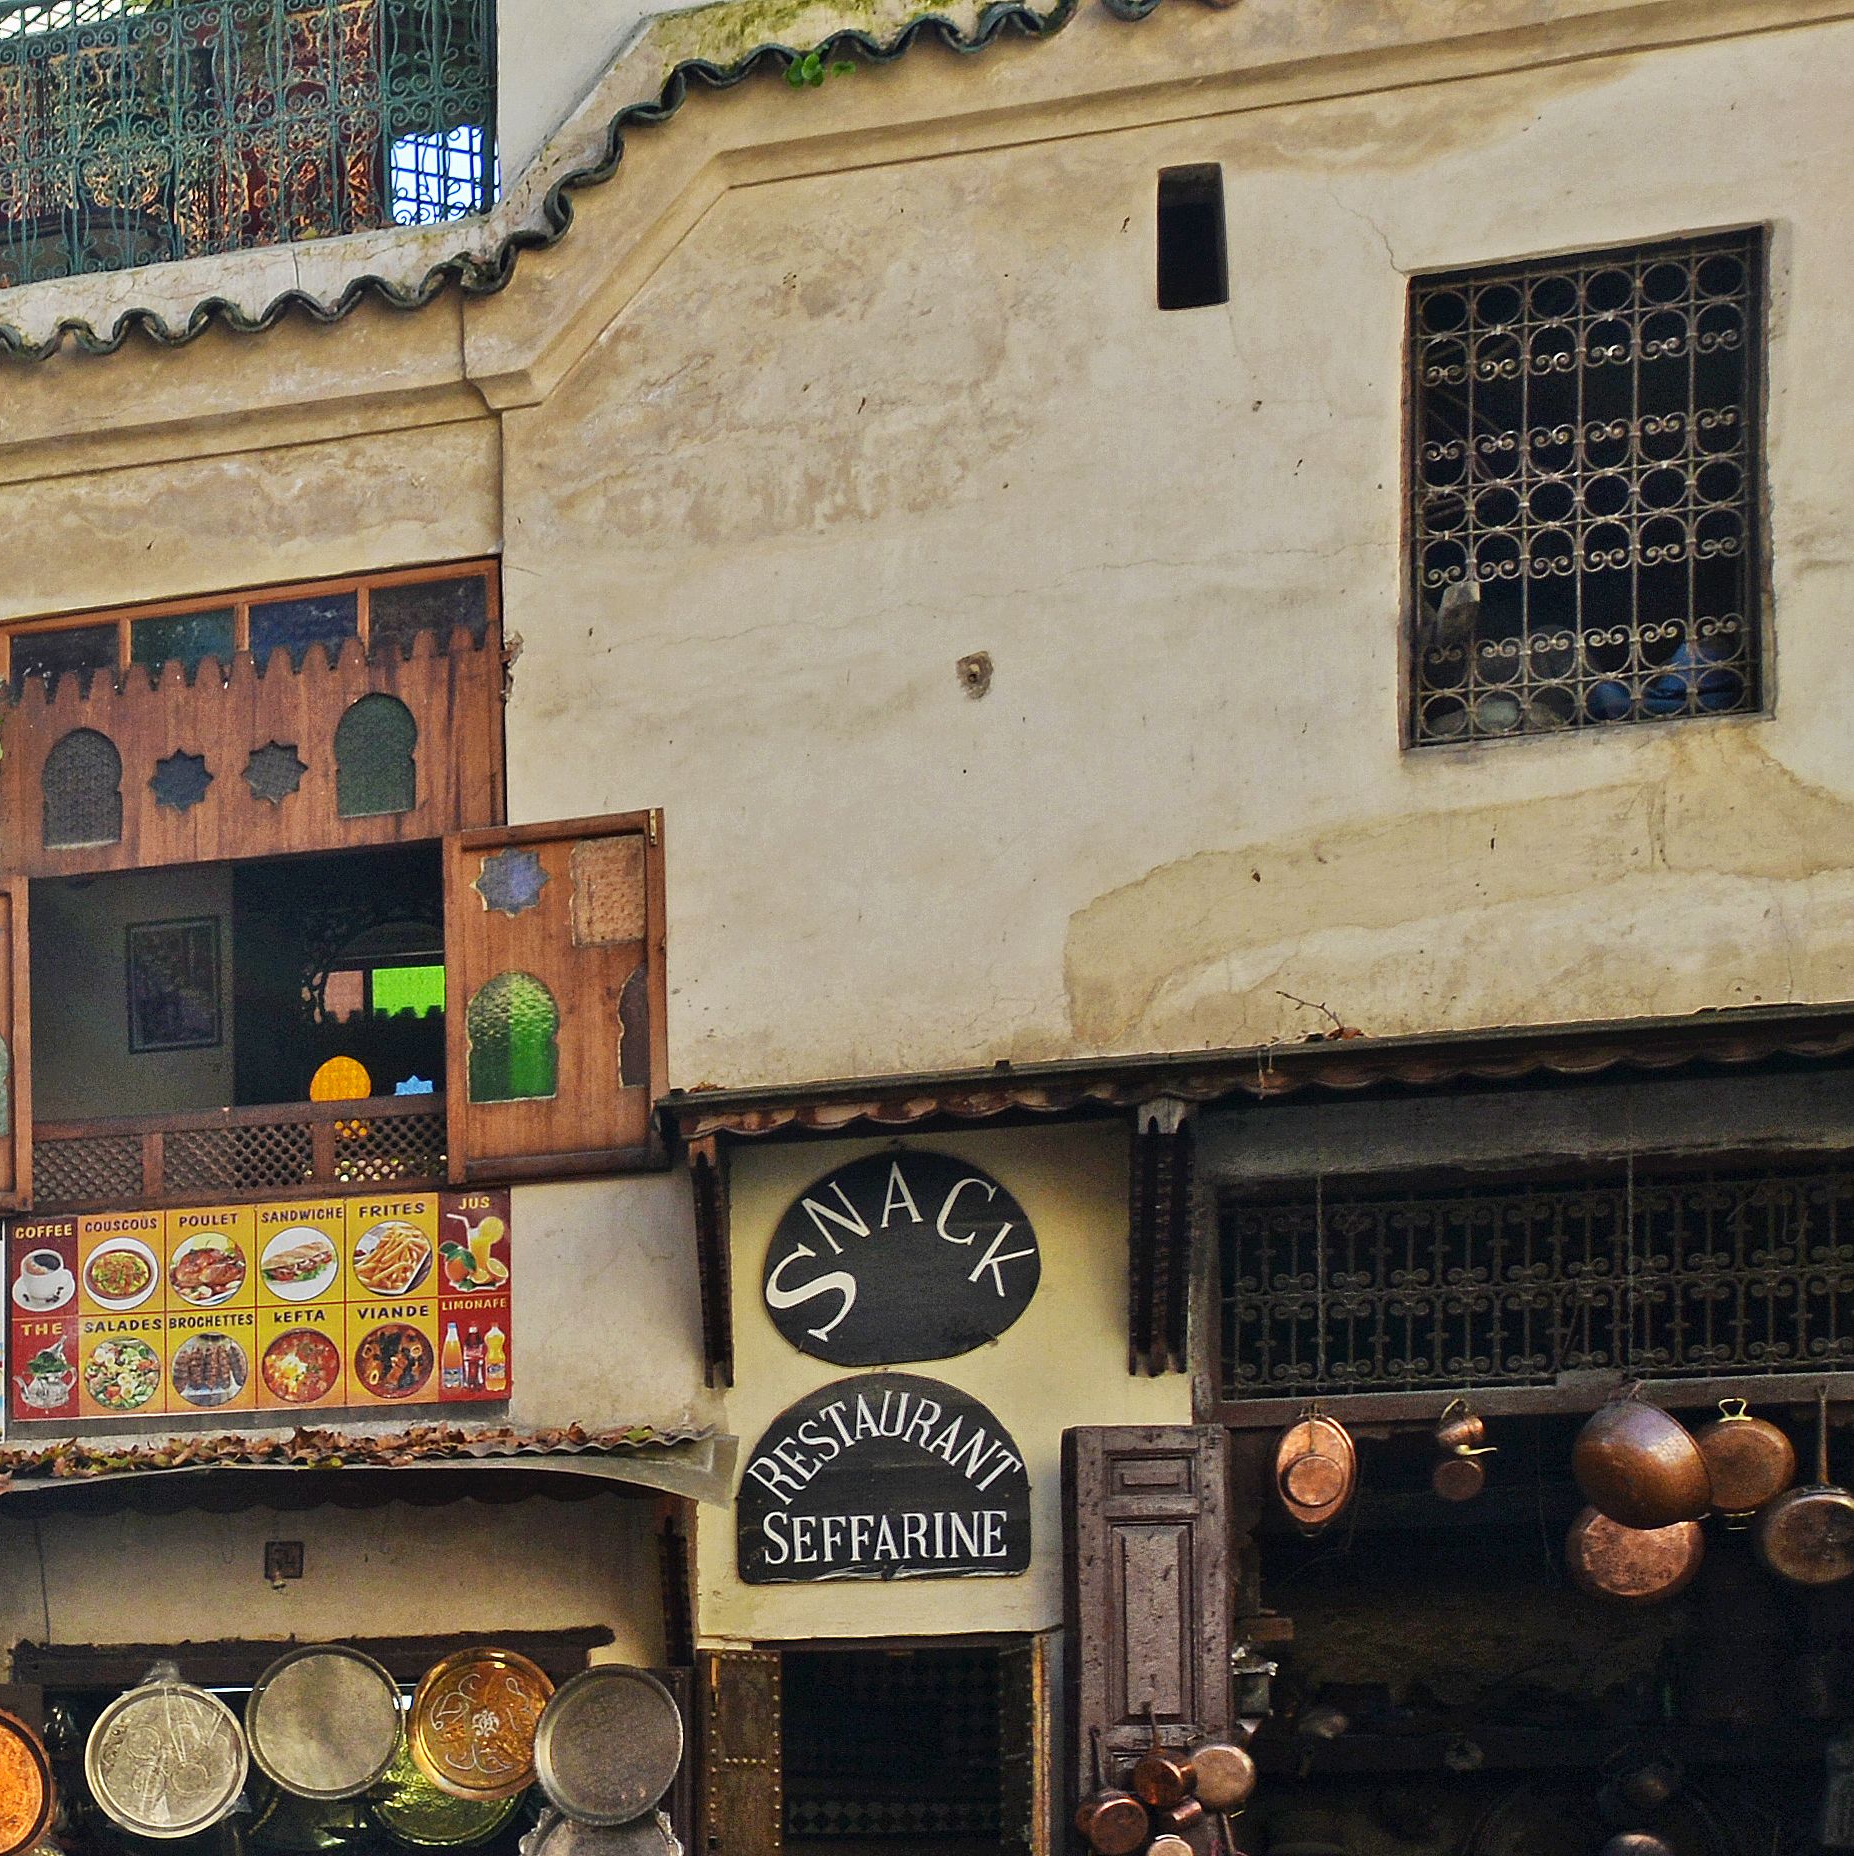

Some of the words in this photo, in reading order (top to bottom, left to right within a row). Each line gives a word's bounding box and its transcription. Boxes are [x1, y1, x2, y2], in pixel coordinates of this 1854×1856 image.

[358, 1202, 427, 1219] FRITES
[457, 1195, 491, 1210] JUS
[178, 1212, 240, 1228] POULET
[260, 1205, 344, 1224] SANDWICHE
[14, 1223, 73, 1239] COFFEE
[84, 1215, 158, 1233] COUSCOUS
[765, 1161, 1034, 1341] SNACK
[357, 1303, 430, 1320] VIANDE
[20, 1322, 63, 1337] THE
[84, 1317, 162, 1334] SALADES
[168, 1312, 254, 1330] BROCHETTES
[748, 1391, 1022, 1504] RESTAURANT
[763, 1510, 1007, 1564] SEFFARINE
